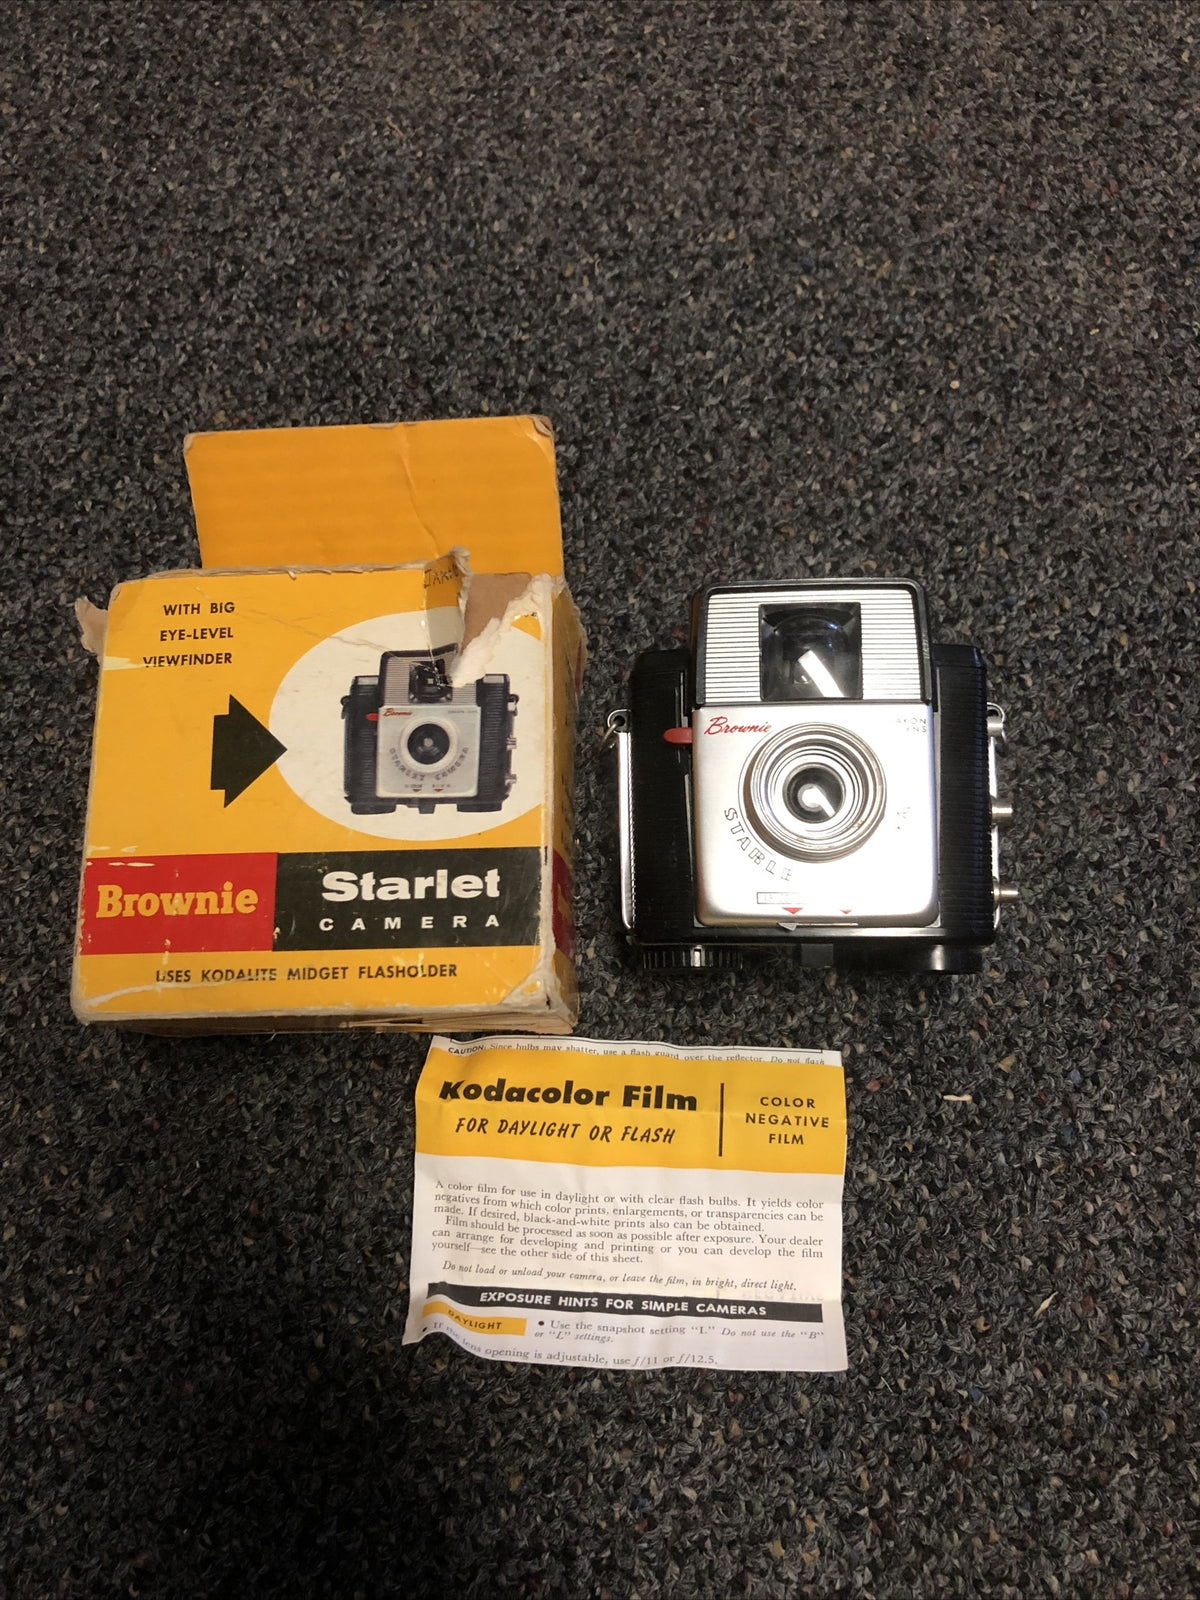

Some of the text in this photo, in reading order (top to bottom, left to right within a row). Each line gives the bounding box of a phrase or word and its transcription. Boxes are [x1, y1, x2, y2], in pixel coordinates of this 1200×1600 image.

[163, 602, 235, 616] WITH BIG
[160, 627, 234, 641] EYE-LEVEL
[143, 653, 233, 668] VIEWFINDER
[704, 716, 772, 735] Brownie
[321, 869, 501, 901] Starlet
[96, 881, 259, 918] Brownie
[318, 914, 501, 933] CAMERA
[156, 963, 457, 983] USES KODALITE MIDGET FLASHOLDER
[439, 1078, 697, 1111] Kodacolor Film
[760, 1096, 816, 1108] COLOR
[745, 1112, 829, 1128] NEGATIVE
[455, 1117, 676, 1144] FOR DAYLIGHT OR FLASH
[768, 1133, 804, 1145] FILM
[436, 1181, 824, 1209] A color film for use in daylight or with clear flash bulbs. It yields color
[435, 1193, 480, 1204] negatives
[483, 1196, 507, 1207] from
[511, 1200, 542, 1211] which
[544, 1203, 572, 1213] color
[612, 1206, 688, 1218] enlargements,
[691, 1210, 703, 1218] or
[706, 1210, 784, 1221] transparencies
[787, 1213, 807, 1221] can
[811, 1211, 824, 1222] be
[434, 1205, 765, 1232] made. If desired, black-and-white prints also can be obtained.
[445, 1215, 468, 1227] Film
[470, 1220, 505, 1232] should
[507, 1222, 520, 1233] be
[522, 1227, 573, 1237] processed
[576, 1230, 587, 1238] as
[617, 1232, 628, 1240] as
[631, 1231, 673, 1242] possible
[676, 1232, 701, 1242] after
[703, 1235, 754, 1245] exposure.
[758, 1234, 786, 1244] Your
[789, 1236, 824, 1246] dealer
[432, 1229, 450, 1237] can
[456, 1231, 494, 1244] arrange
[500, 1234, 515, 1244] for
[520, 1236, 578, 1251] developing
[584, 1241, 605, 1250] and
[610, 1242, 655, 1254] printing
[678, 1246, 698, 1256] you
[703, 1247, 723, 1255] can
[729, 1246, 772, 1258] develop
[778, 1247, 796, 1257] the
[801, 1248, 823, 1258] film
[500, 1246, 517, 1256] the
[520, 1248, 549, 1258] other
[551, 1250, 573, 1260] side
[576, 1252, 588, 1261] of
[590, 1252, 609, 1262] this
[612, 1253, 643, 1263] sheet.
[443, 1260, 456, 1270] Do
[459, 1264, 472, 1273] not
[475, 1264, 496, 1275] load
[499, 1267, 508, 1275] or
[511, 1267, 544, 1277] unload
[544, 1271, 566, 1280] your
[569, 1272, 606, 1282] camera,
[622, 1273, 646, 1282] leave
[649, 1274, 664, 1284] the
[665, 1275, 689, 1286] film,
[692, 1277, 702, 1286] in
[705, 1277, 738, 1289] bright,
[741, 1279, 768, 1289] direct
[770, 1279, 797, 1292] light.
[480, 1292, 767, 1316] EXPOSURE HINTS FOR SIMPLE CAMERAS
[448, 1309, 503, 1330] DAYLIGHT
[550, 1320, 571, 1330] Use
[575, 1320, 592, 1331] the
[597, 1322, 645, 1334] snapshot
[650, 1324, 686, 1336] setting
[721, 1327, 736, 1337] Do
[740, 1329, 756, 1337] not
[761, 1330, 777, 1338] use
[781, 1329, 796, 1338] the
[574, 1333, 614, 1344] settings.
[485, 1347, 530, 1360] opening
[534, 1350, 543, 1359] is
[547, 1349, 609, 1365] adjustable,
[613, 1357, 631, 1366] use
[663, 1355, 676, 1364] or
